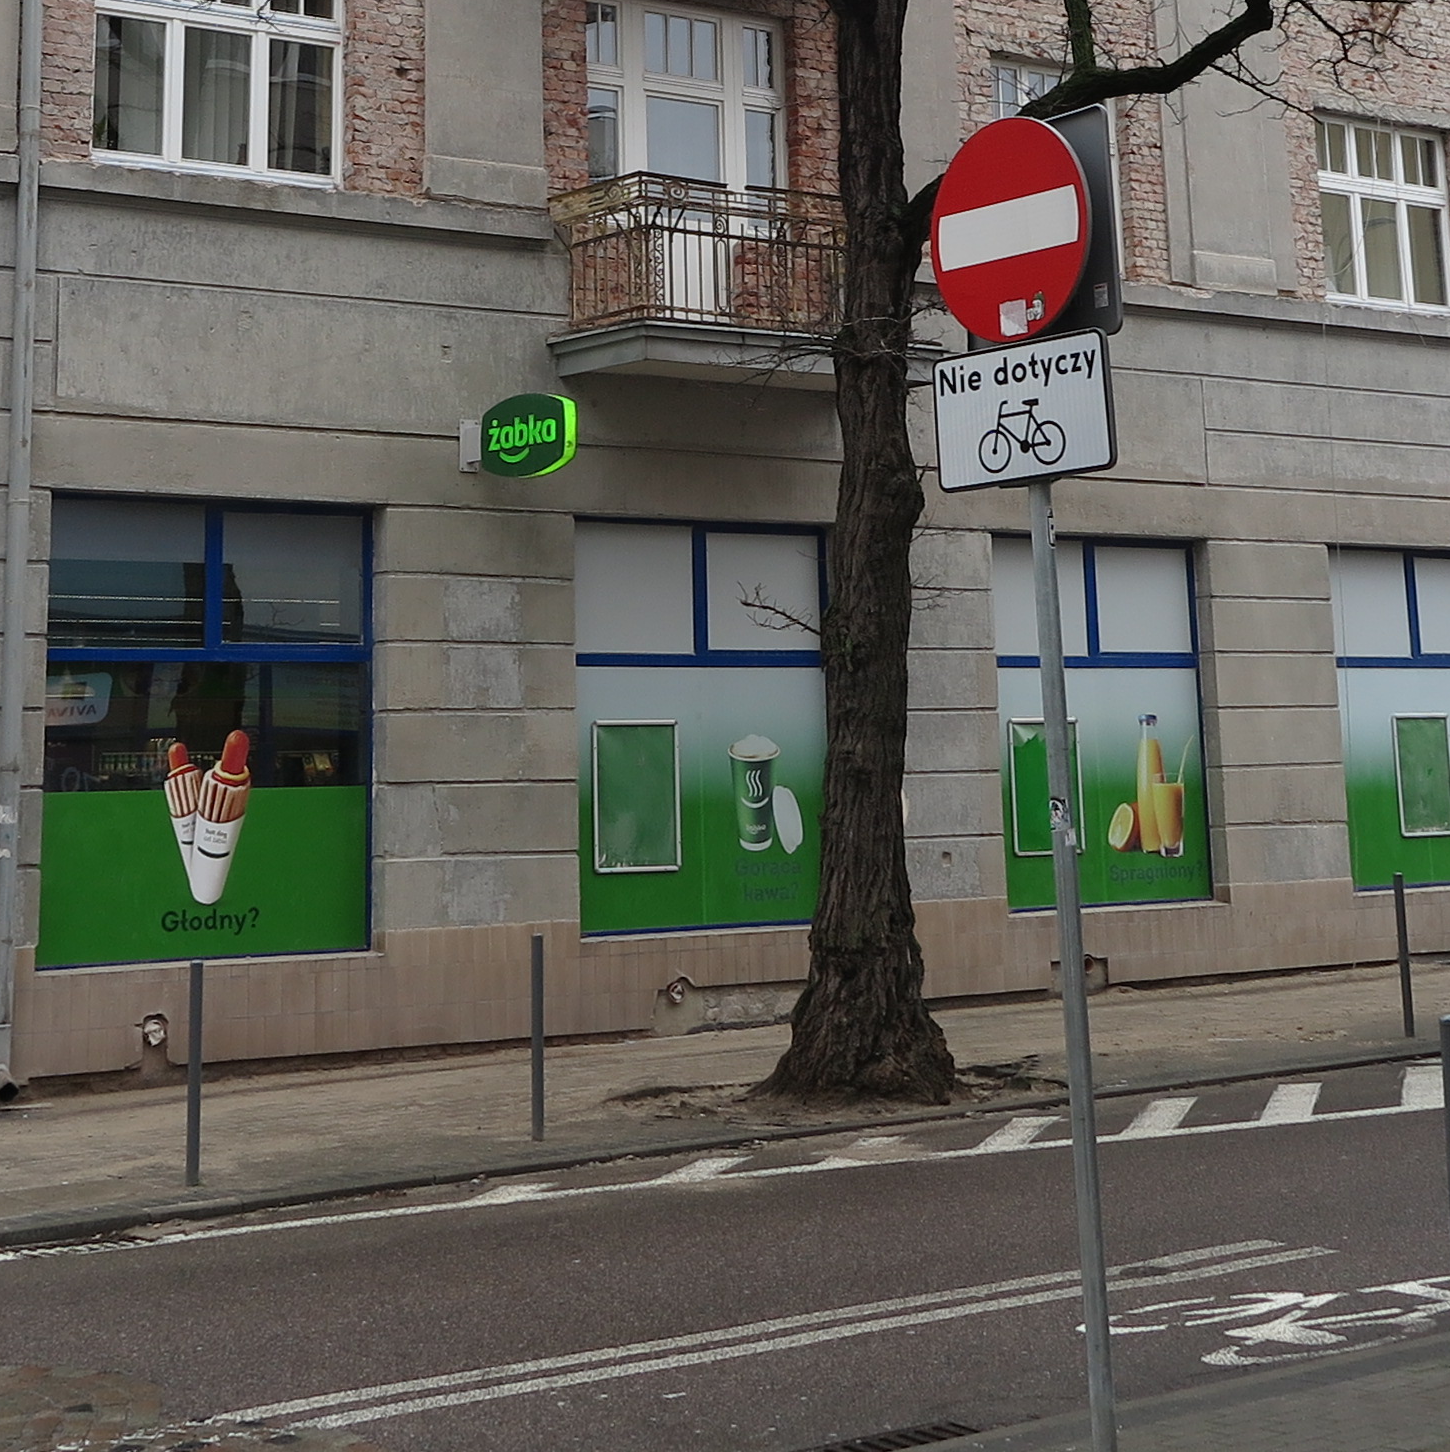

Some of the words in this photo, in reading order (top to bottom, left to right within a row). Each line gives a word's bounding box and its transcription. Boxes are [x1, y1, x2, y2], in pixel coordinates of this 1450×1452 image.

[938, 365, 982, 397] Nie
[993, 349, 1097, 387] dotyczy
[488, 414, 556, 452] żabka
[161, 907, 260, 936] Głodny?
